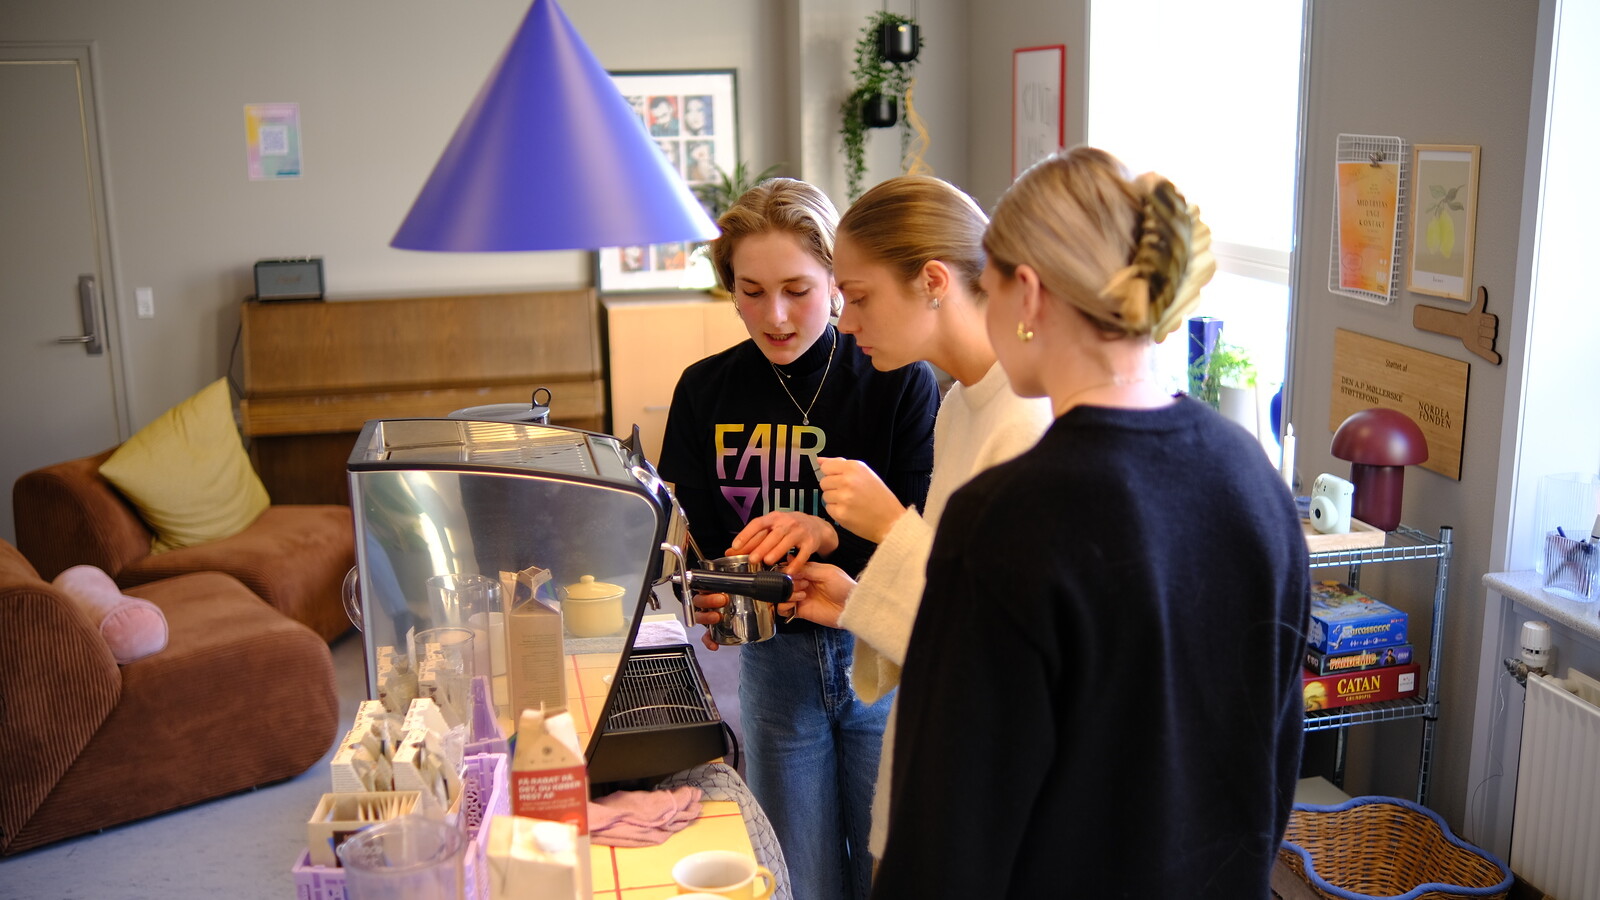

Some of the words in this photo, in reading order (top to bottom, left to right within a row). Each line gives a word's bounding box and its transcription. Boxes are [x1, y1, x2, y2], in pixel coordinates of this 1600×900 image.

[1385, 360, 1401, 371] Støttet
[1341, 376, 1354, 387] DEN
[1366, 384, 1402, 403] MØLLERSKE
[1341, 387, 1379, 404] STØTTEFOND
[1418, 401, 1450, 420] NORDEA
[1419, 410, 1451, 429] FONDEN
[715, 423, 827, 482] FAIR
[1329, 654, 1376, 670] PANDEMIC
[1337, 675, 1380, 694] CATAN
